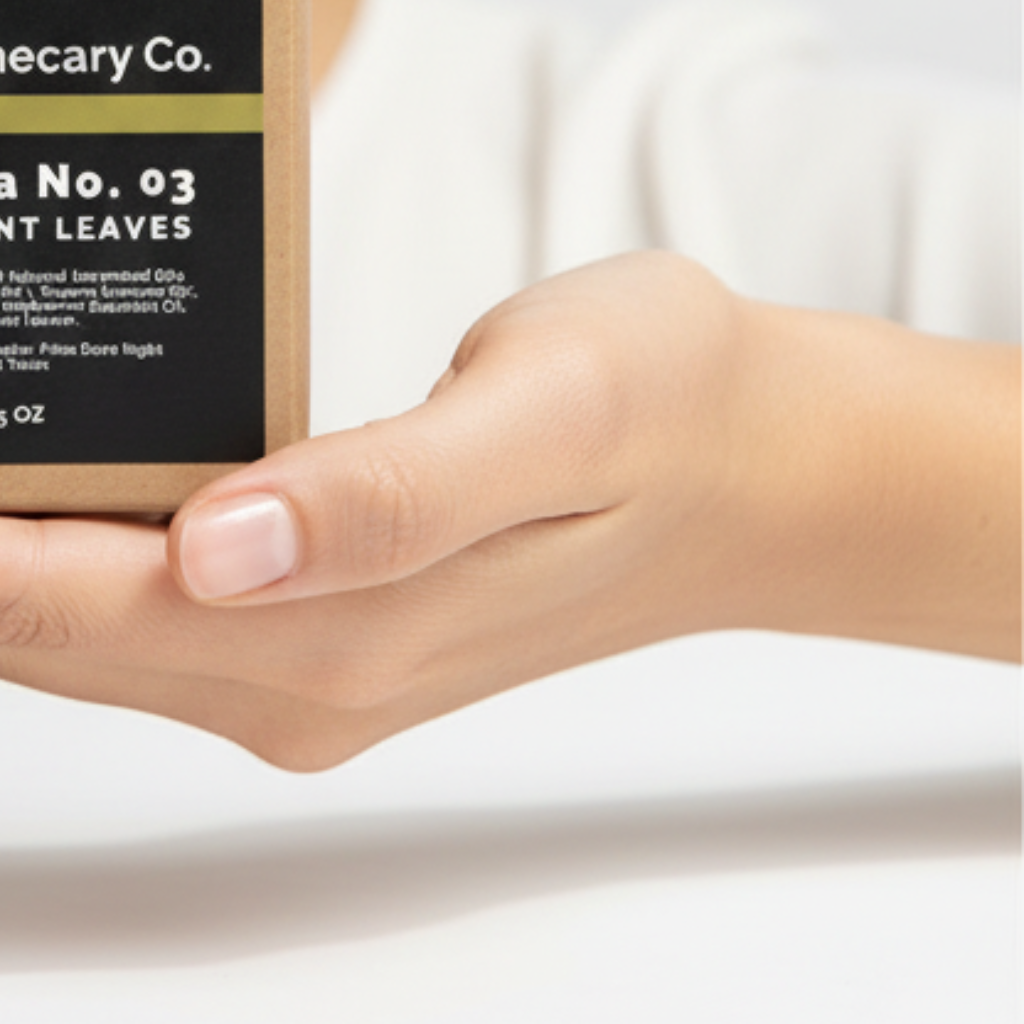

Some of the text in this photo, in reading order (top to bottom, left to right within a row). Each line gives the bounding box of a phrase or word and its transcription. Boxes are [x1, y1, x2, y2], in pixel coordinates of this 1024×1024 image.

[143, 35, 212, 73] Co.
[37, 162, 121, 200] No.
[139, 167, 196, 206] 03
[55, 214, 192, 241] LEAVES
[12, 404, 45, 424] OZ
